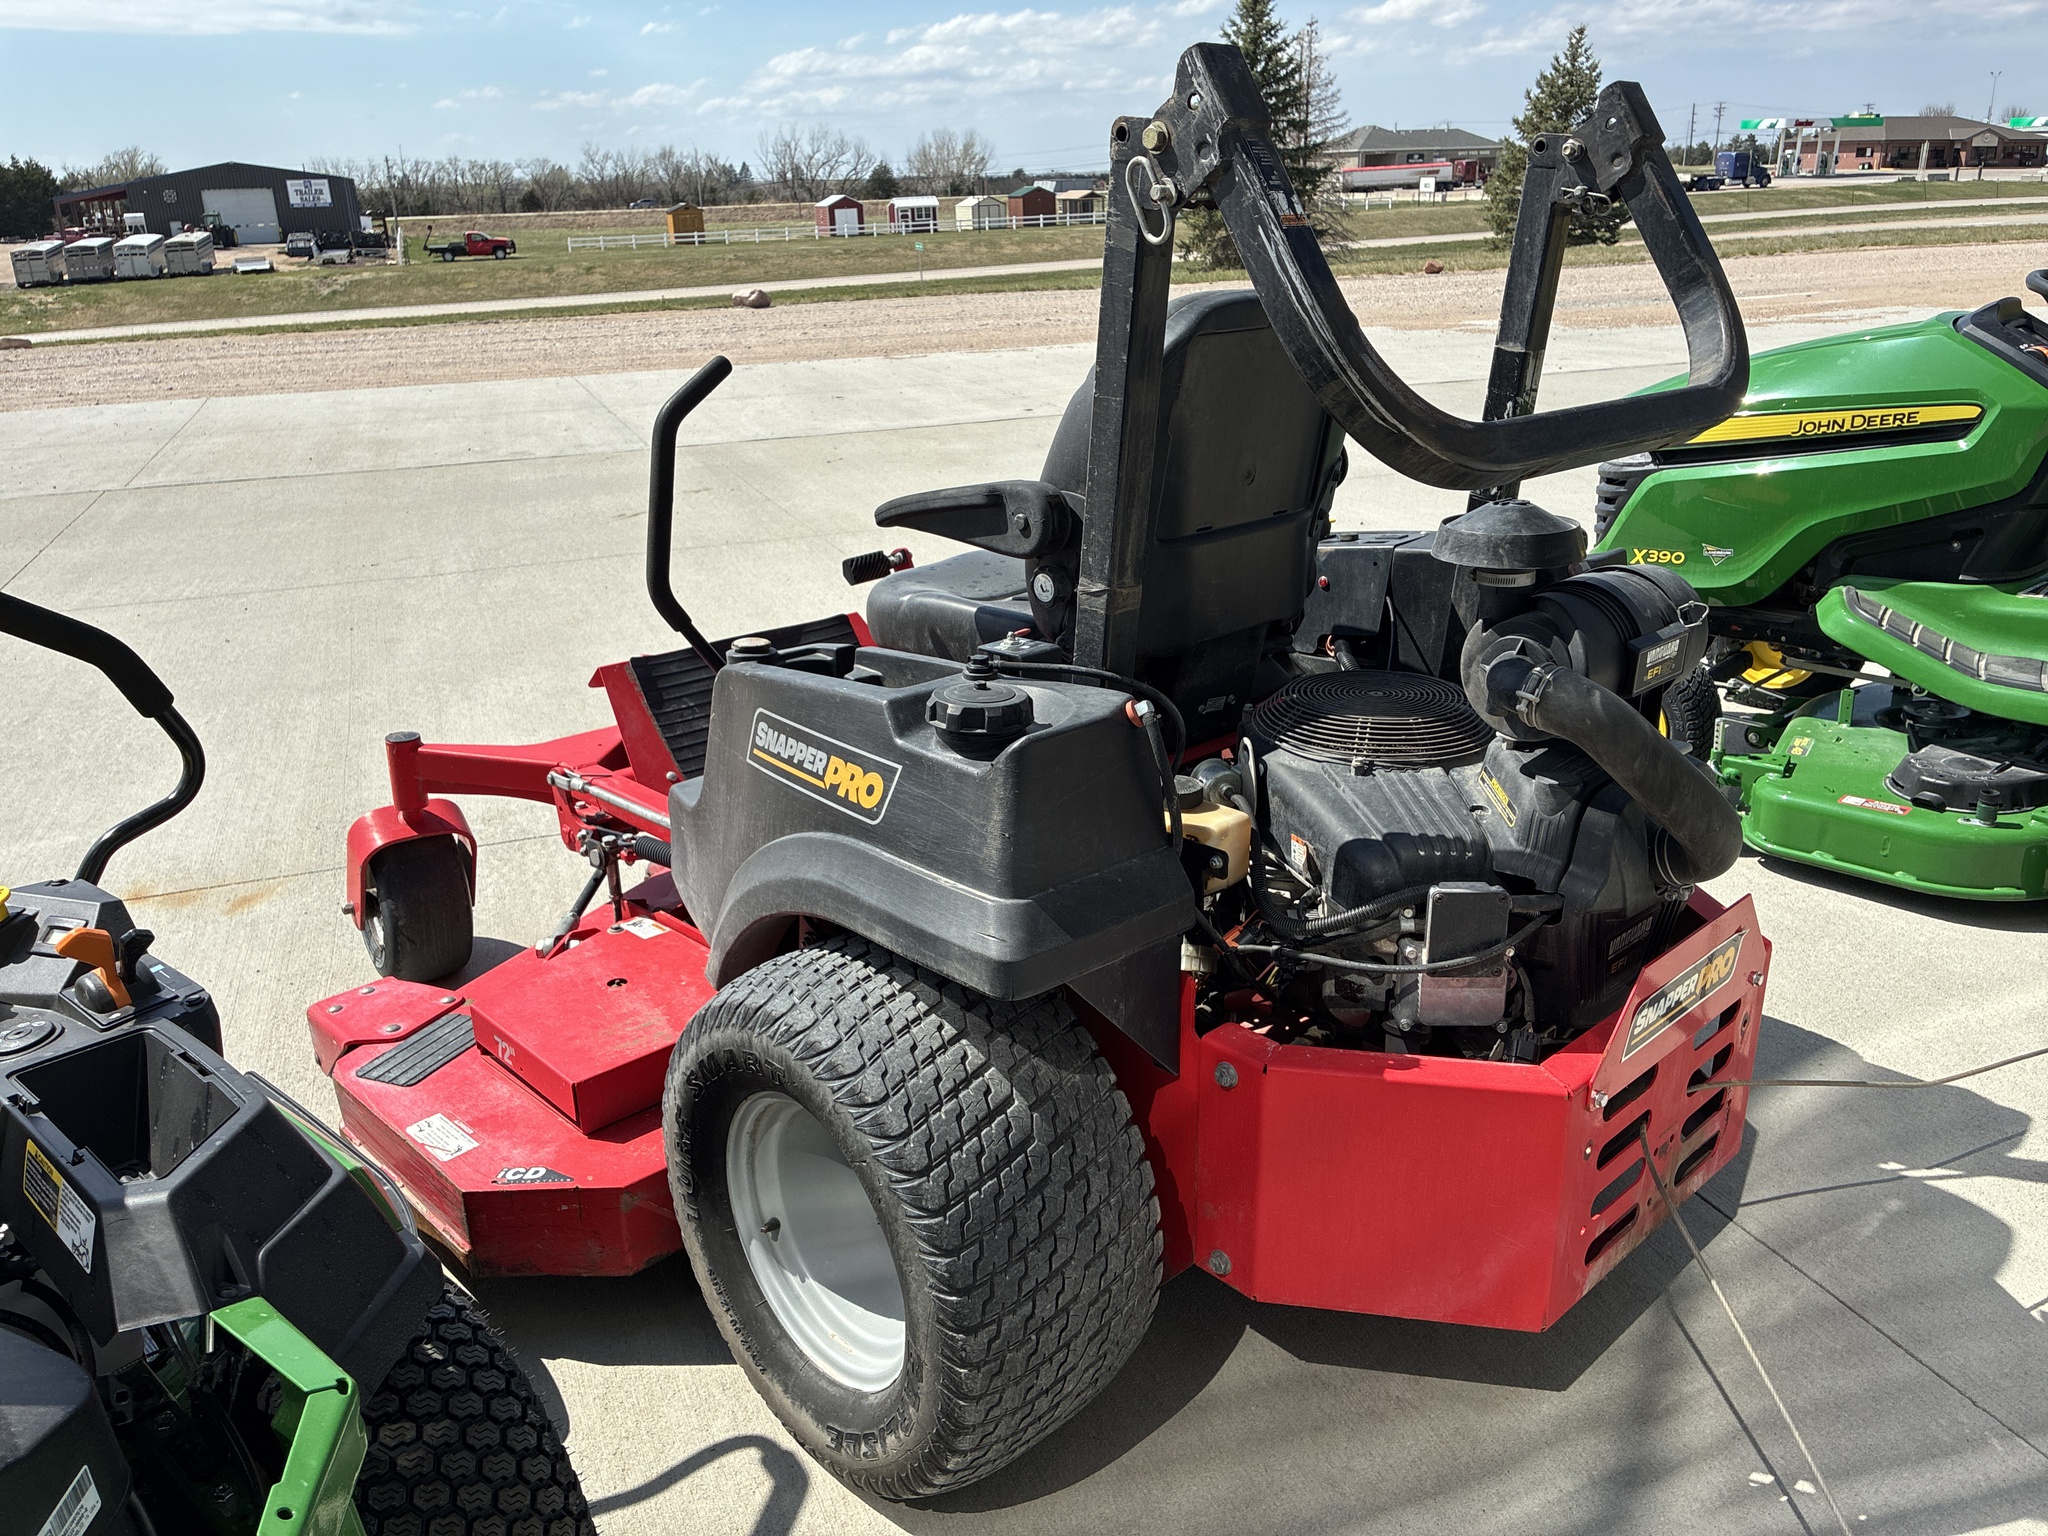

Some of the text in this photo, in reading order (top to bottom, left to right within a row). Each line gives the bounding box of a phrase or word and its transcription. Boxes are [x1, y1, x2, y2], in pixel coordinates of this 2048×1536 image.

[1791, 411, 1920, 435] JOHN DEERE
[1629, 548, 1685, 565] X390
[1647, 665, 1662, 680] EFI
[755, 721, 884, 809] SNAPPER PRO
[1634, 946, 1735, 1035] SNAPPER PRO
[686, 1049, 786, 1102] SMART
